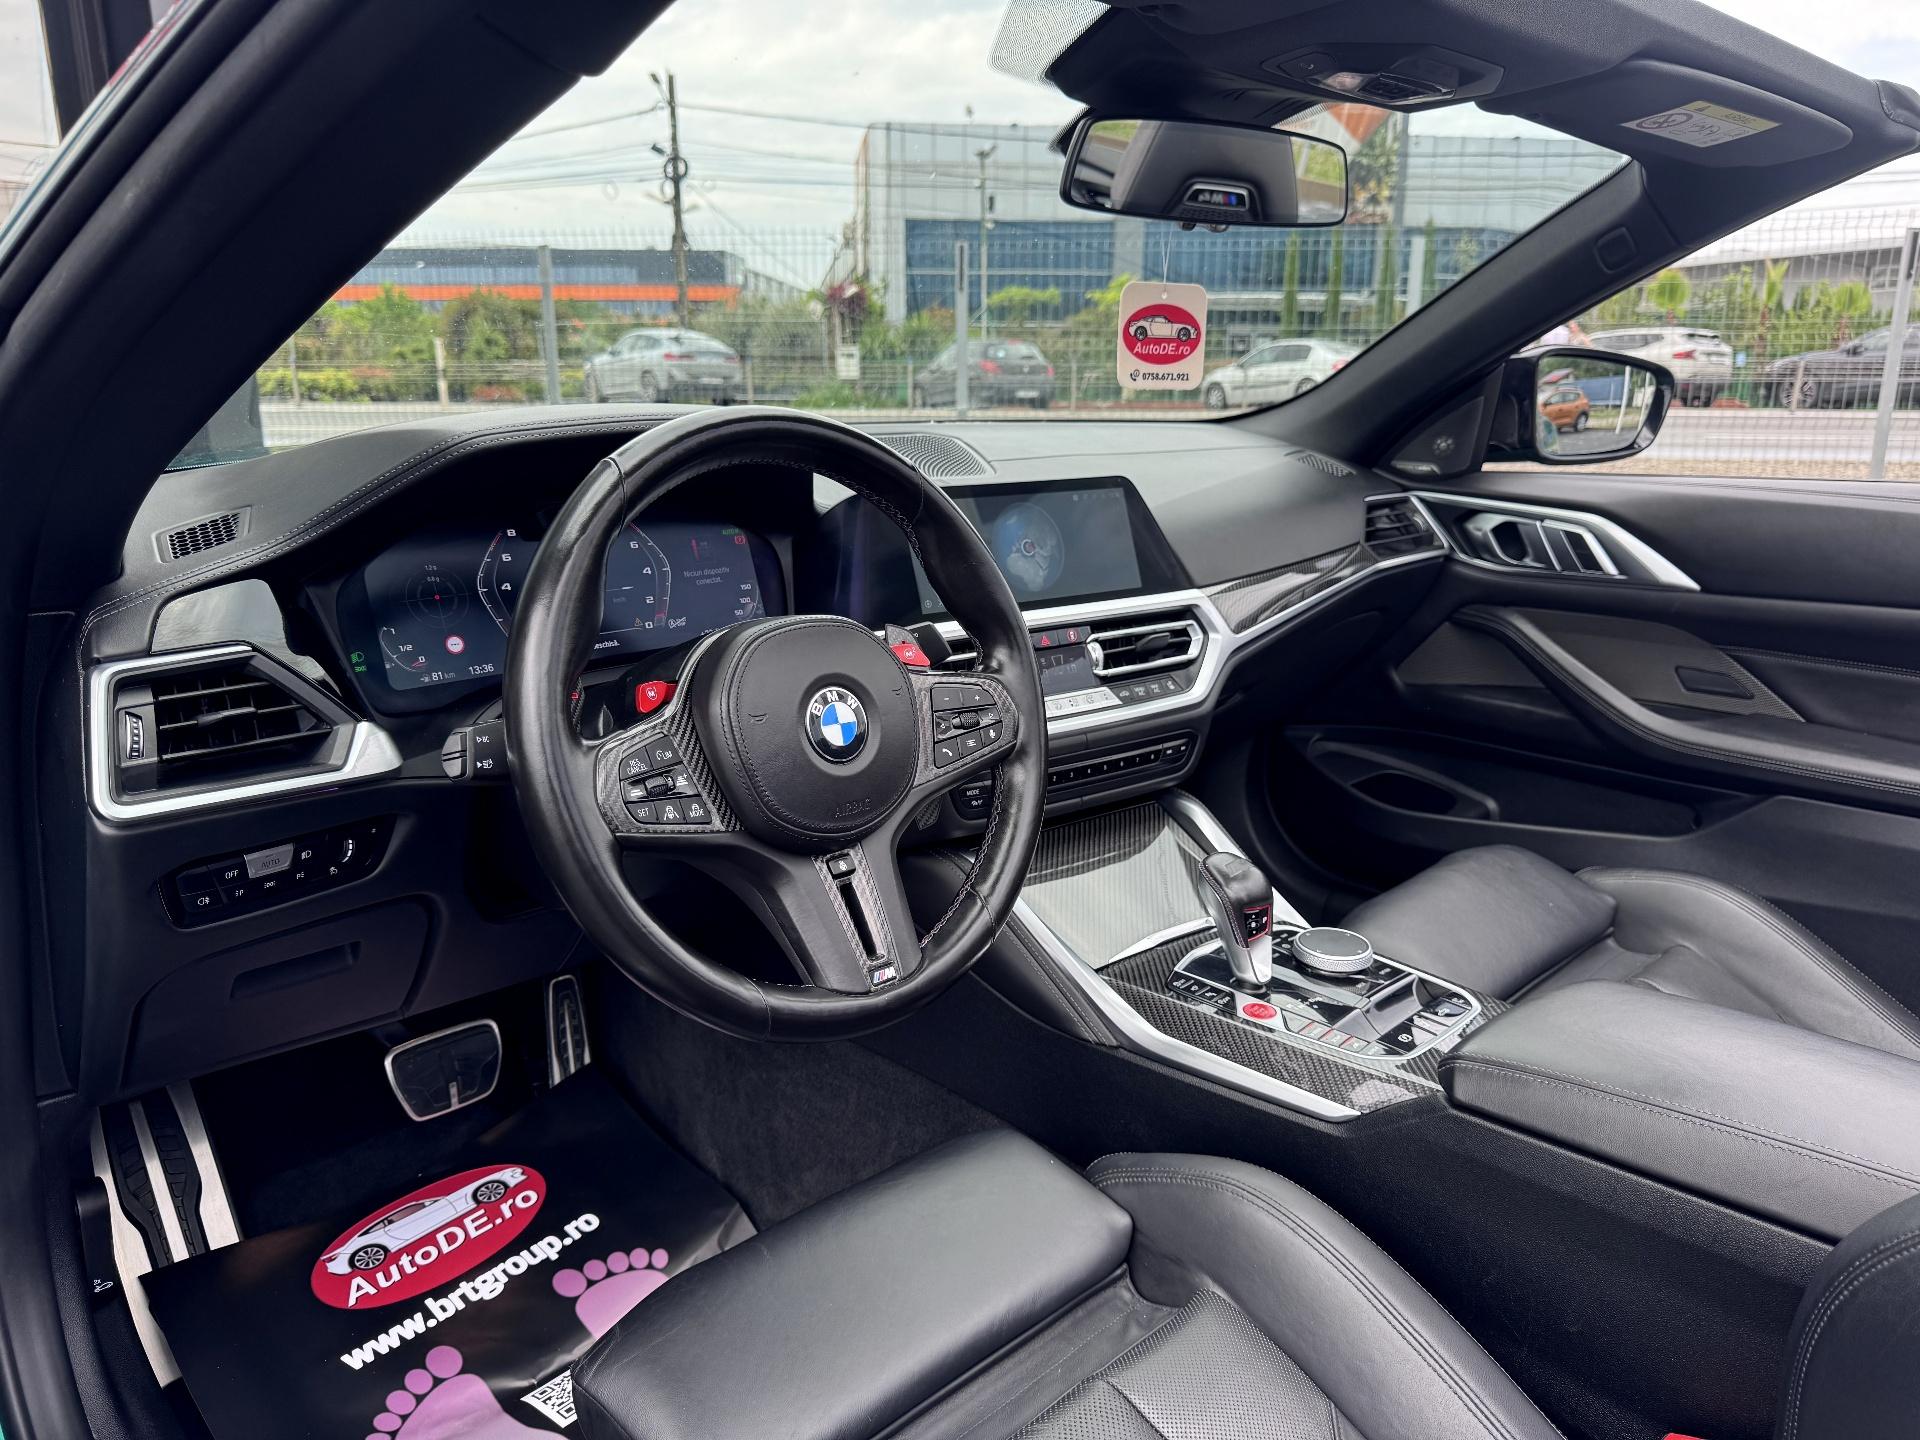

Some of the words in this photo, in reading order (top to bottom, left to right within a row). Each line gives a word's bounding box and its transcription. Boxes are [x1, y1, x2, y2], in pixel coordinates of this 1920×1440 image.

[1133, 343, 1190, 355] AutoDE.ro
[1142, 372, 1189, 381] 0758.671.921
[630, 541, 639, 549] 6
[502, 554, 511, 562] 6
[643, 567, 652, 575] 4
[501, 583, 512, 591] 4
[645, 596, 655, 604] 2
[645, 621, 654, 629] 0
[468, 664, 494, 676] 13:36
[432, 671, 444, 681] 81
[444, 671, 456, 680] km
[811, 690, 859, 716] BMW
[637, 807, 649, 817] SET
[262, 859, 280, 868] AUTO
[225, 869, 238, 879] OFF
[348, 1188, 539, 1308] AutoDE.ro
[340, 1213, 600, 1371] www.brtgroup.ro
